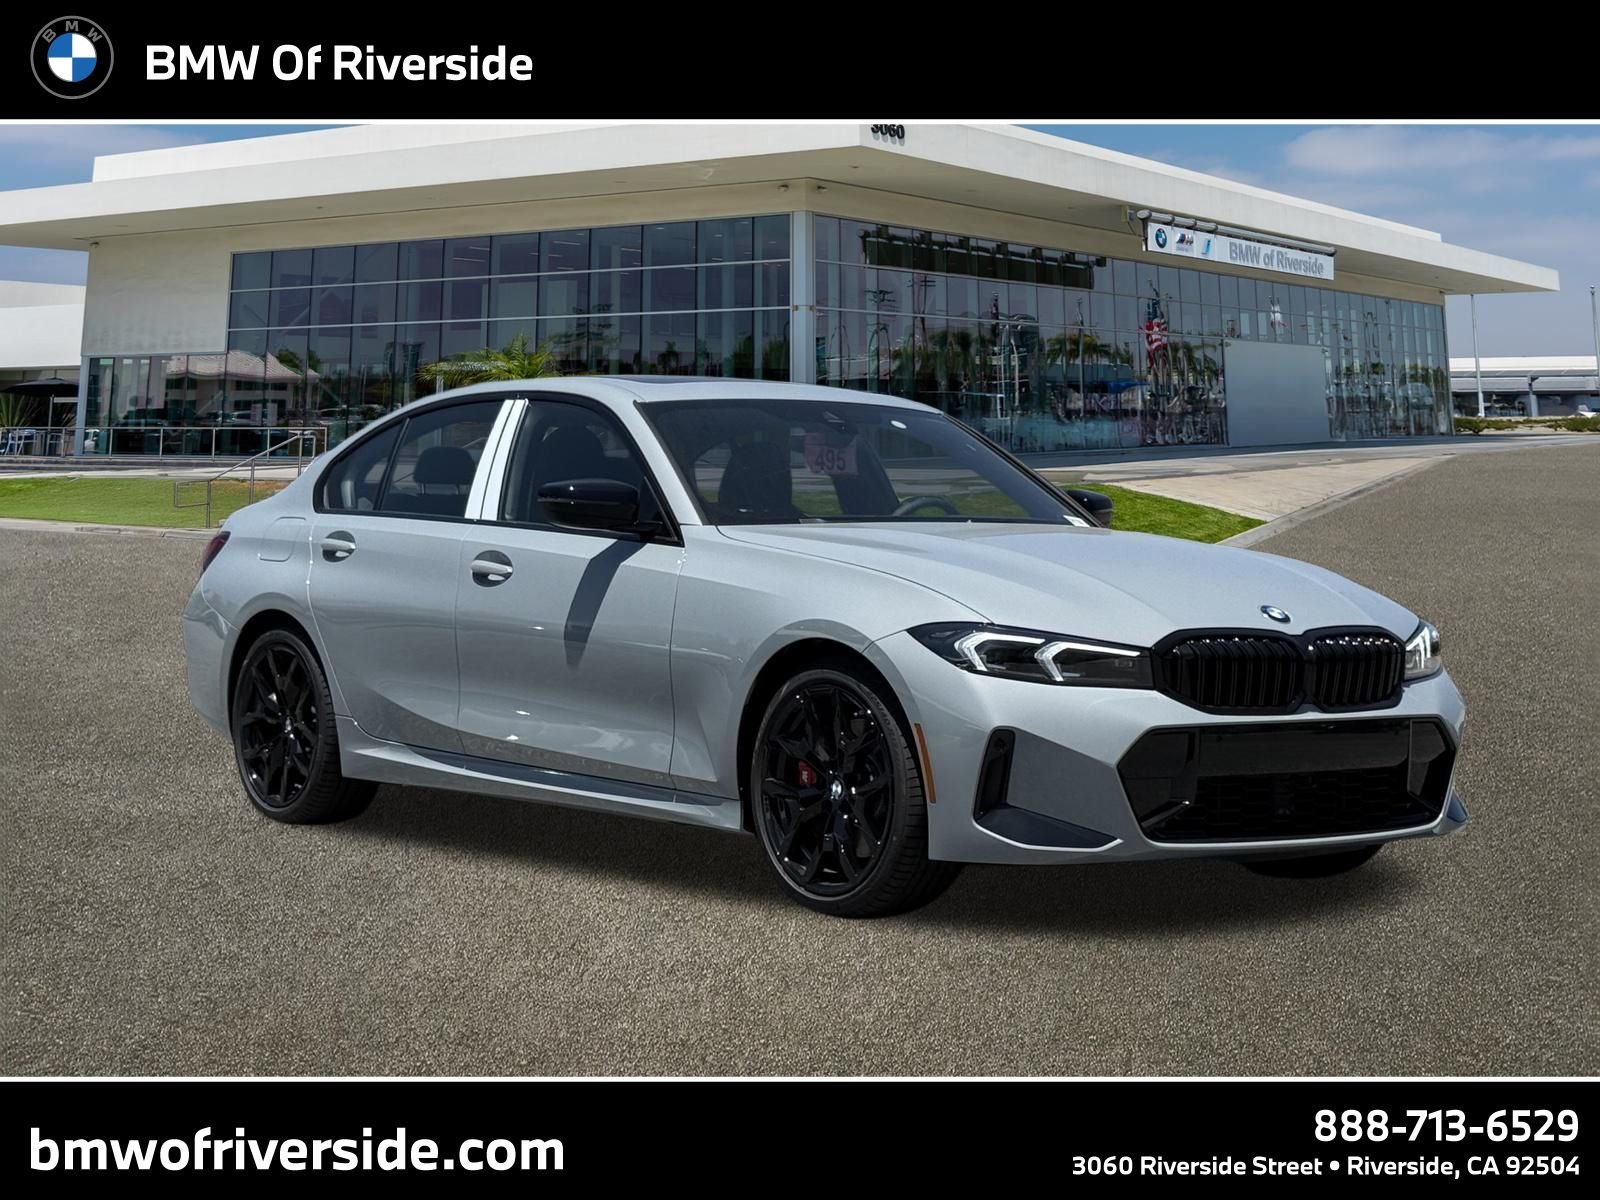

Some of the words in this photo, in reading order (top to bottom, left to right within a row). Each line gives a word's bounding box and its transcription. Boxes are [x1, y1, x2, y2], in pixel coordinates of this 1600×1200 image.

[1229, 241, 1261, 265] BMW
[1263, 249, 1275, 269] of
[1276, 250, 1325, 275] Riverside
[815, 448, 847, 472] 495
